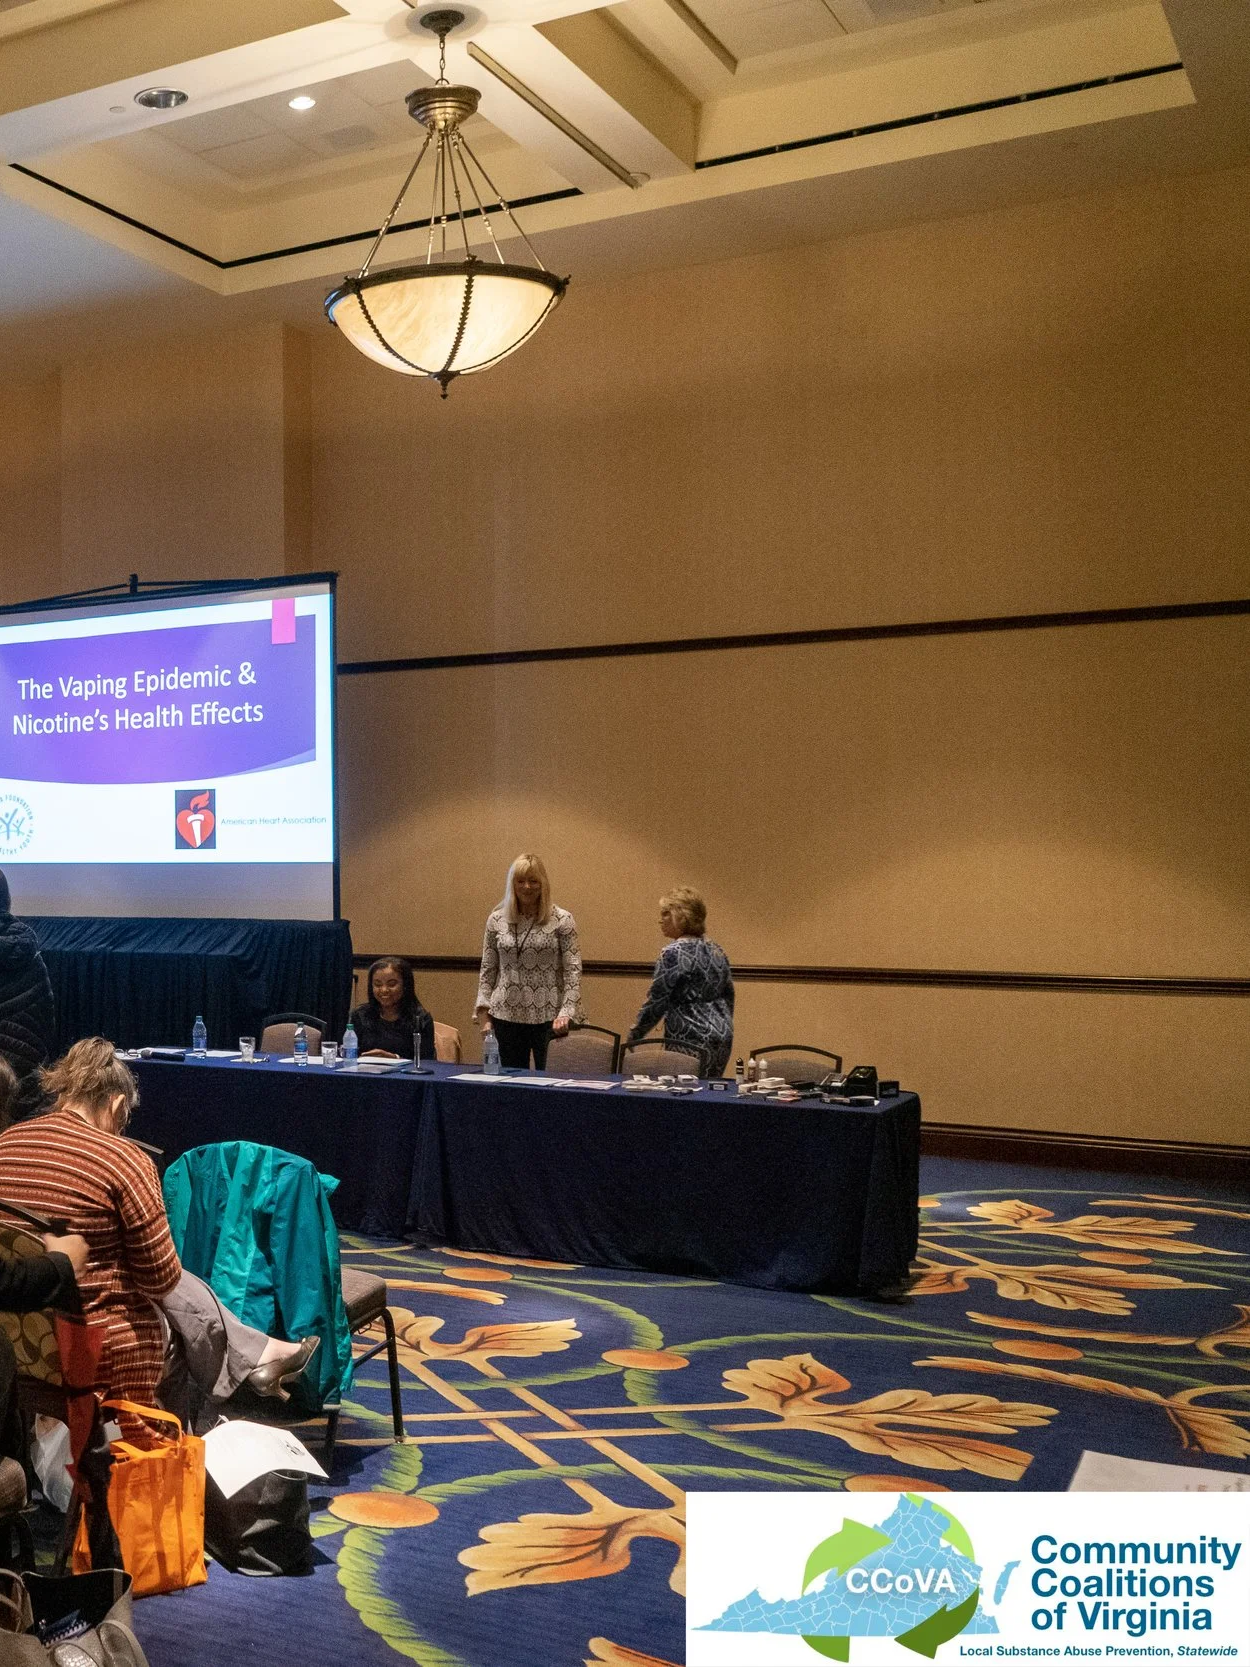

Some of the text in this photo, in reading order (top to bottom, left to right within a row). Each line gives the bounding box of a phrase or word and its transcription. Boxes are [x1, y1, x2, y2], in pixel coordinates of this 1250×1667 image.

[16, 661, 257, 701] The Vaping Epidemic &
[12, 701, 264, 736] Nicotine's Health Effects
[220, 816, 327, 826] American Heart Association
